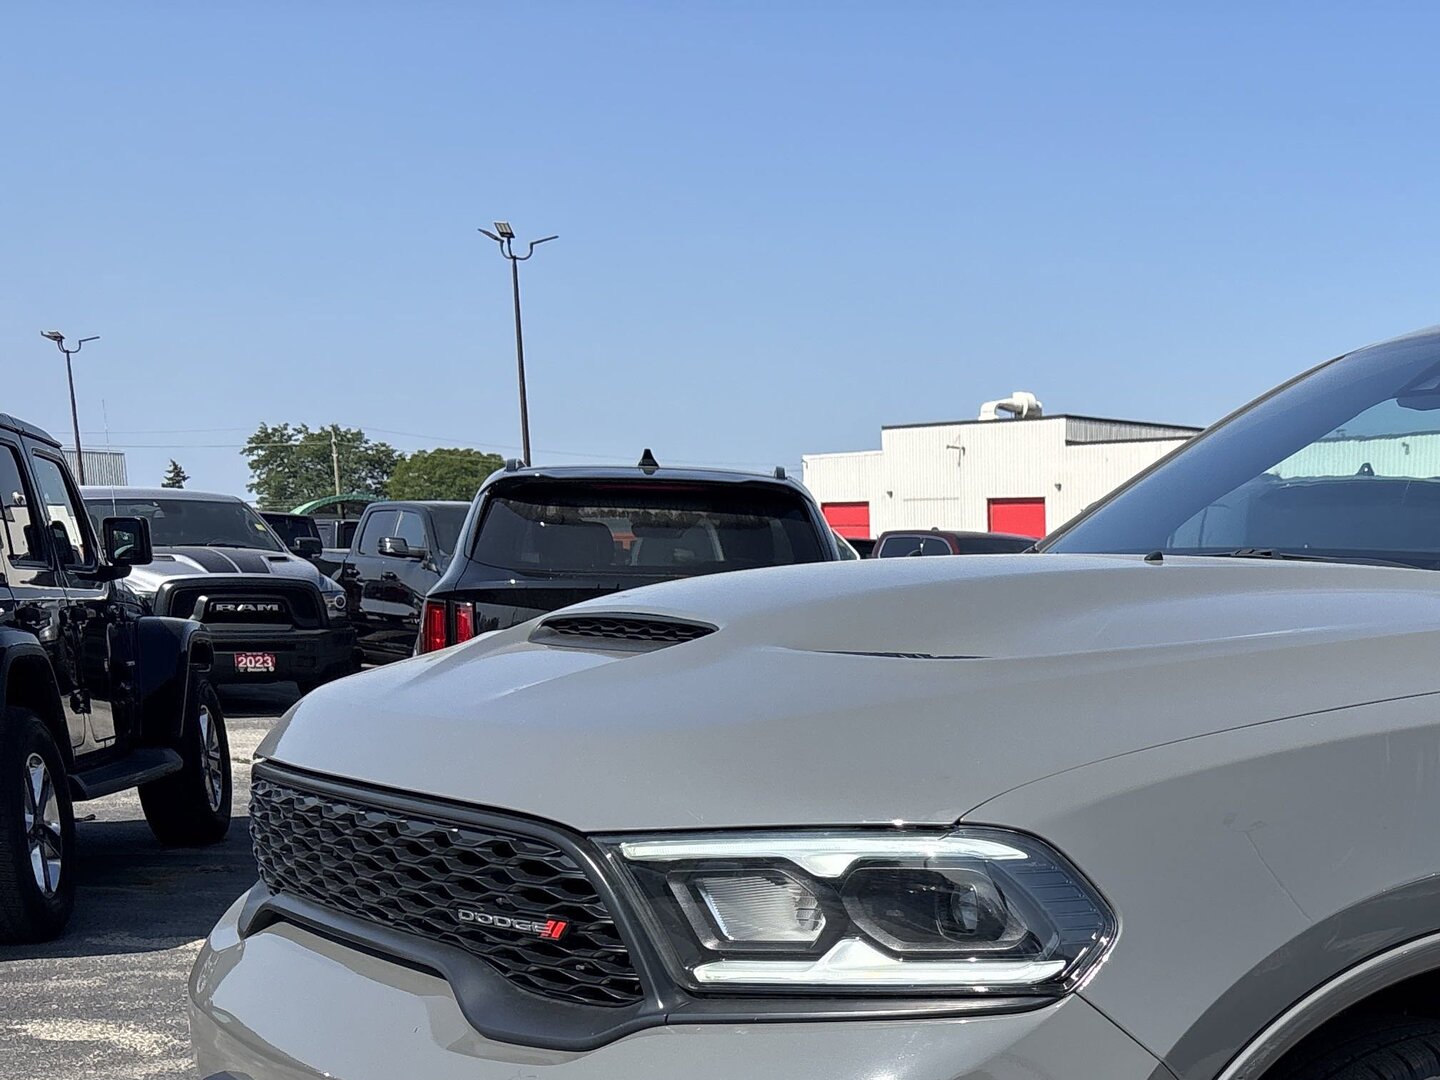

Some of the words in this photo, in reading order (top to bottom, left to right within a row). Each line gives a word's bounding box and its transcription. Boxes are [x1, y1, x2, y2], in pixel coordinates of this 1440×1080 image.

[215, 603, 279, 612] RAM
[237, 656, 272, 668] 2023
[457, 908, 552, 934] DODGE
